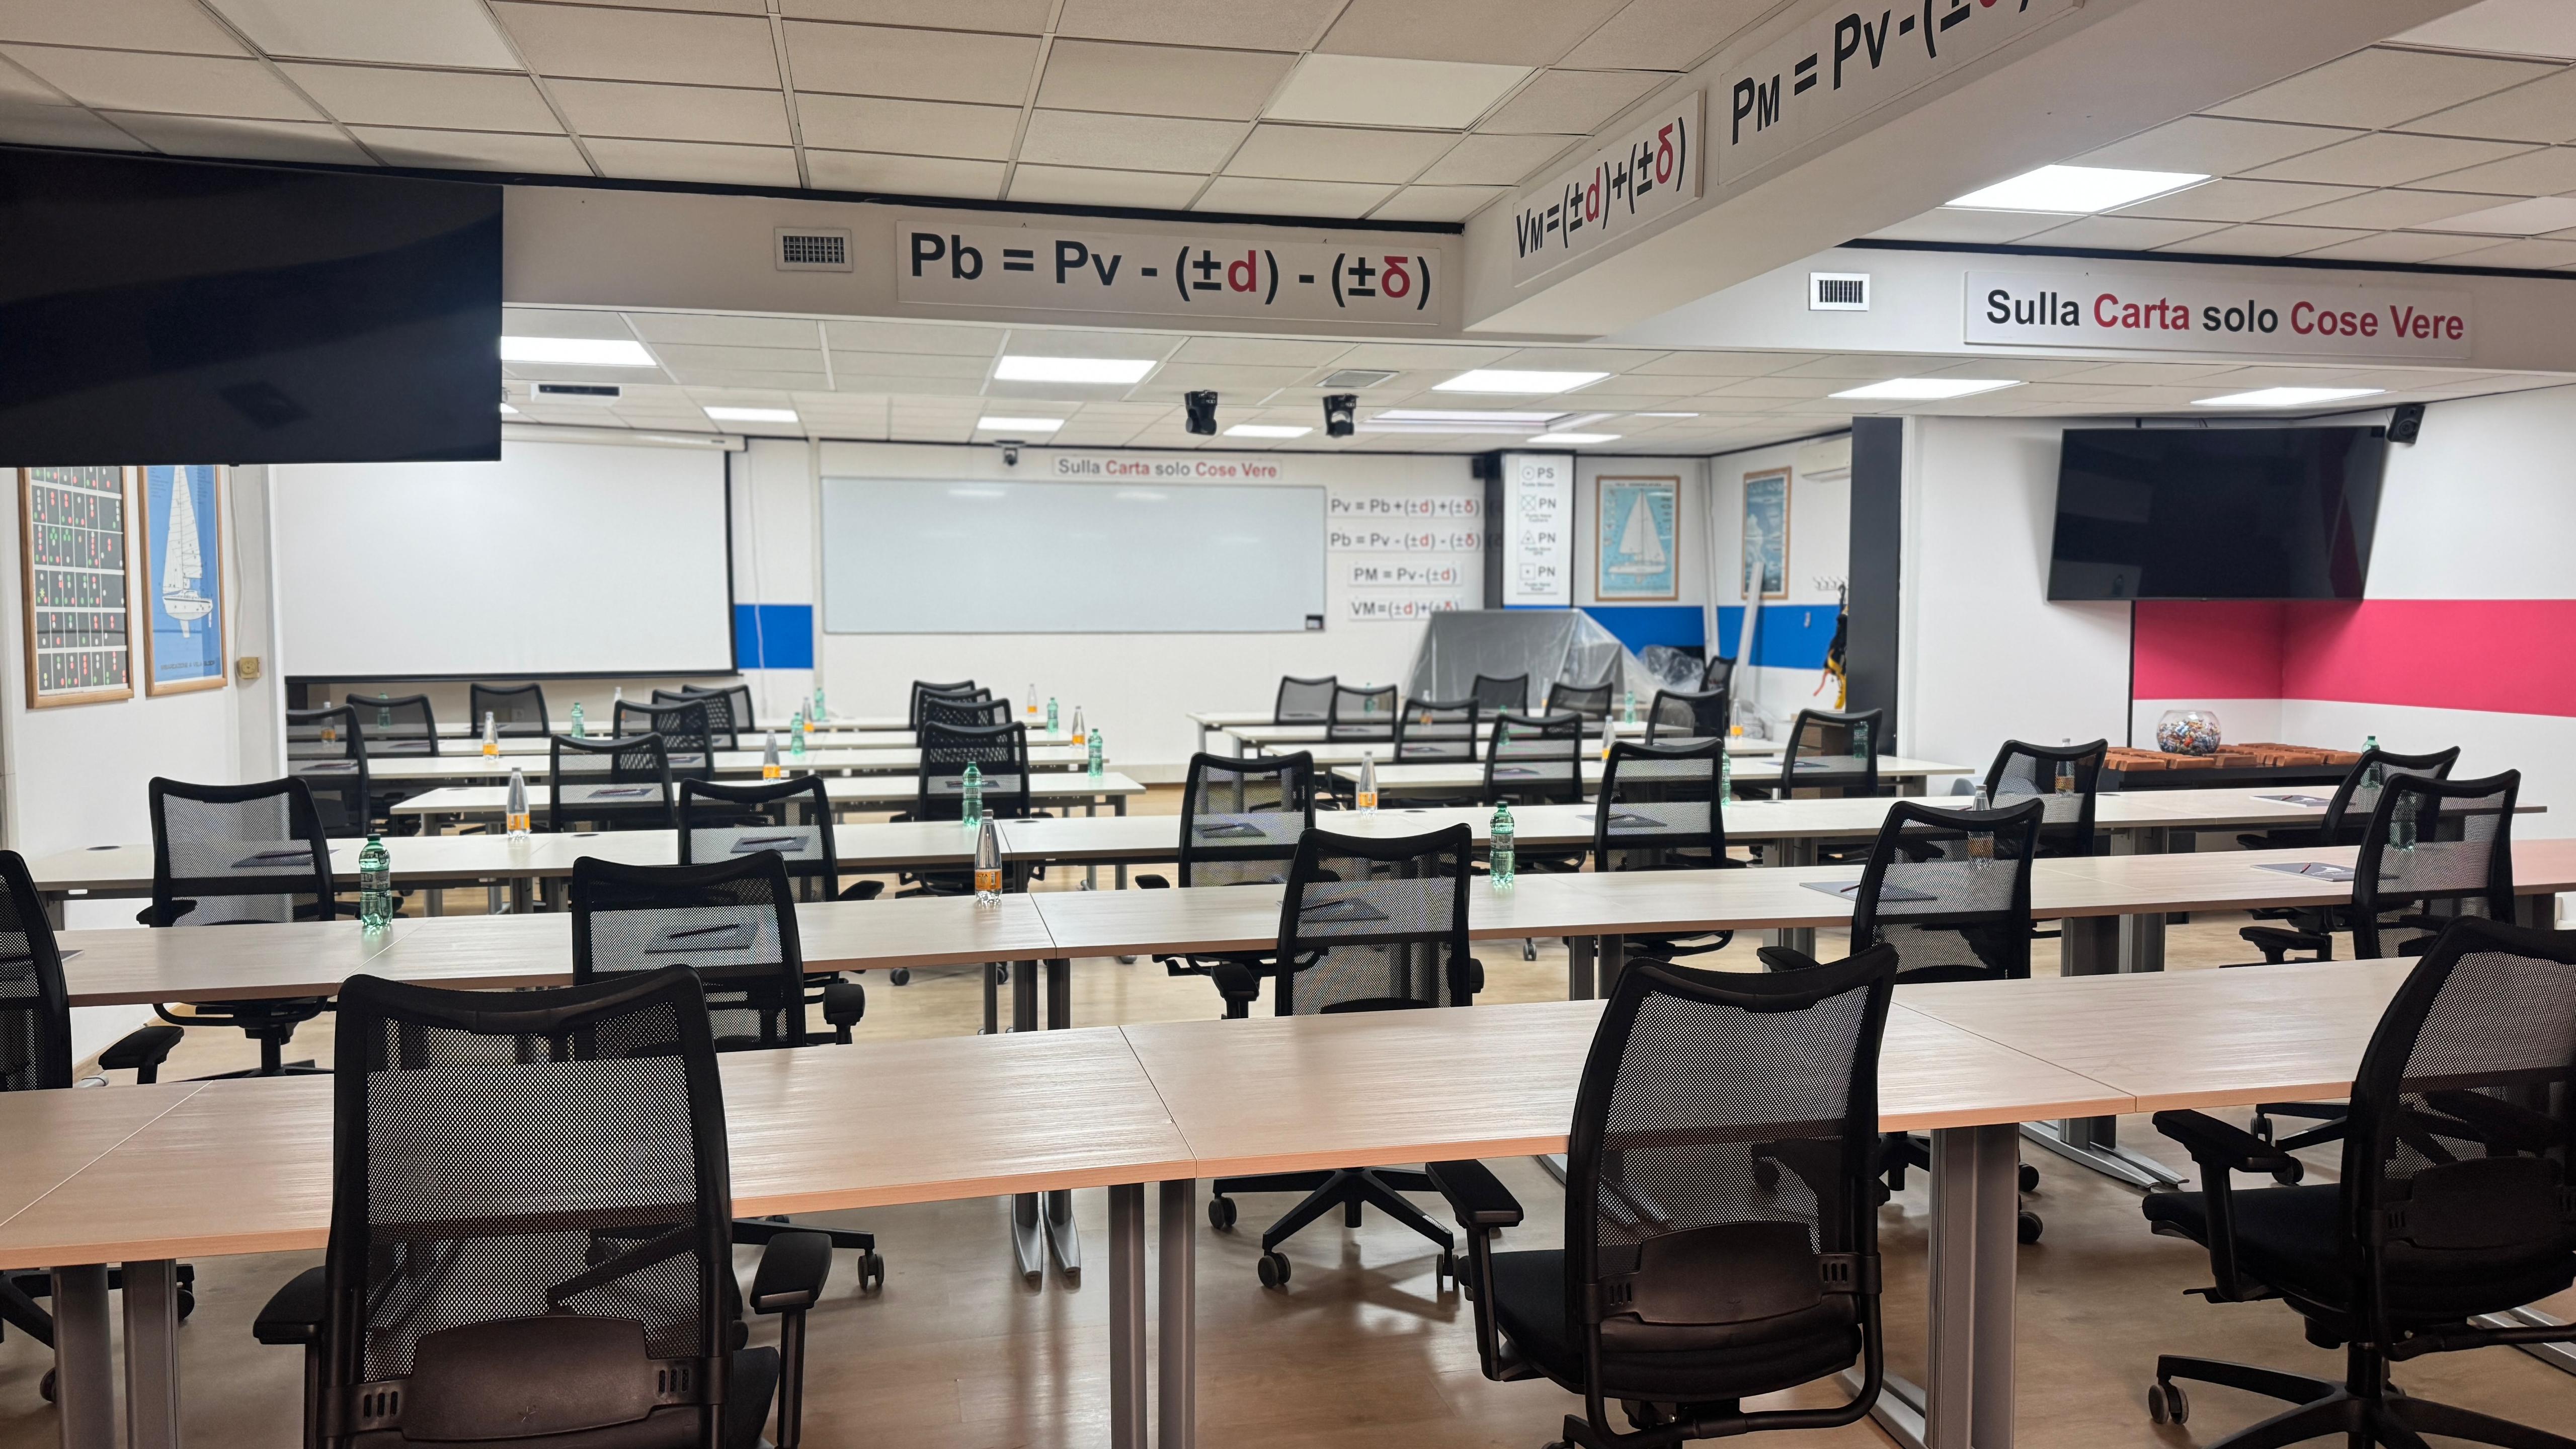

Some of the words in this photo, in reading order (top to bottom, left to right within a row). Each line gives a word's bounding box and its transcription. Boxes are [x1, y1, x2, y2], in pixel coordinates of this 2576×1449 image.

[912, 232, 983, 280] Pb
[1003, 249, 1033, 271] =
[1056, 240, 1122, 285] Pv
[1987, 289, 2080, 327] Sulla
[2094, 293, 2190, 331] Carta
[2203, 299, 2278, 334] solo
[2291, 301, 2378, 337] Cose
[2390, 305, 2464, 340] Vere
[1058, 458, 1100, 474] Sulla
[1105, 460, 1150, 475] Carta
[1155, 462, 1190, 476] solo
[1195, 462, 1237, 477] Cose
[1241, 462, 1277, 478] Vere
[1538, 467, 1555, 479] PS
[1539, 498, 1556, 509] PN
[1330, 532, 1351, 547] Pb
[1539, 532, 1556, 543] PN
[1354, 568, 1378, 581] PM
[1538, 566, 1556, 577] PN
